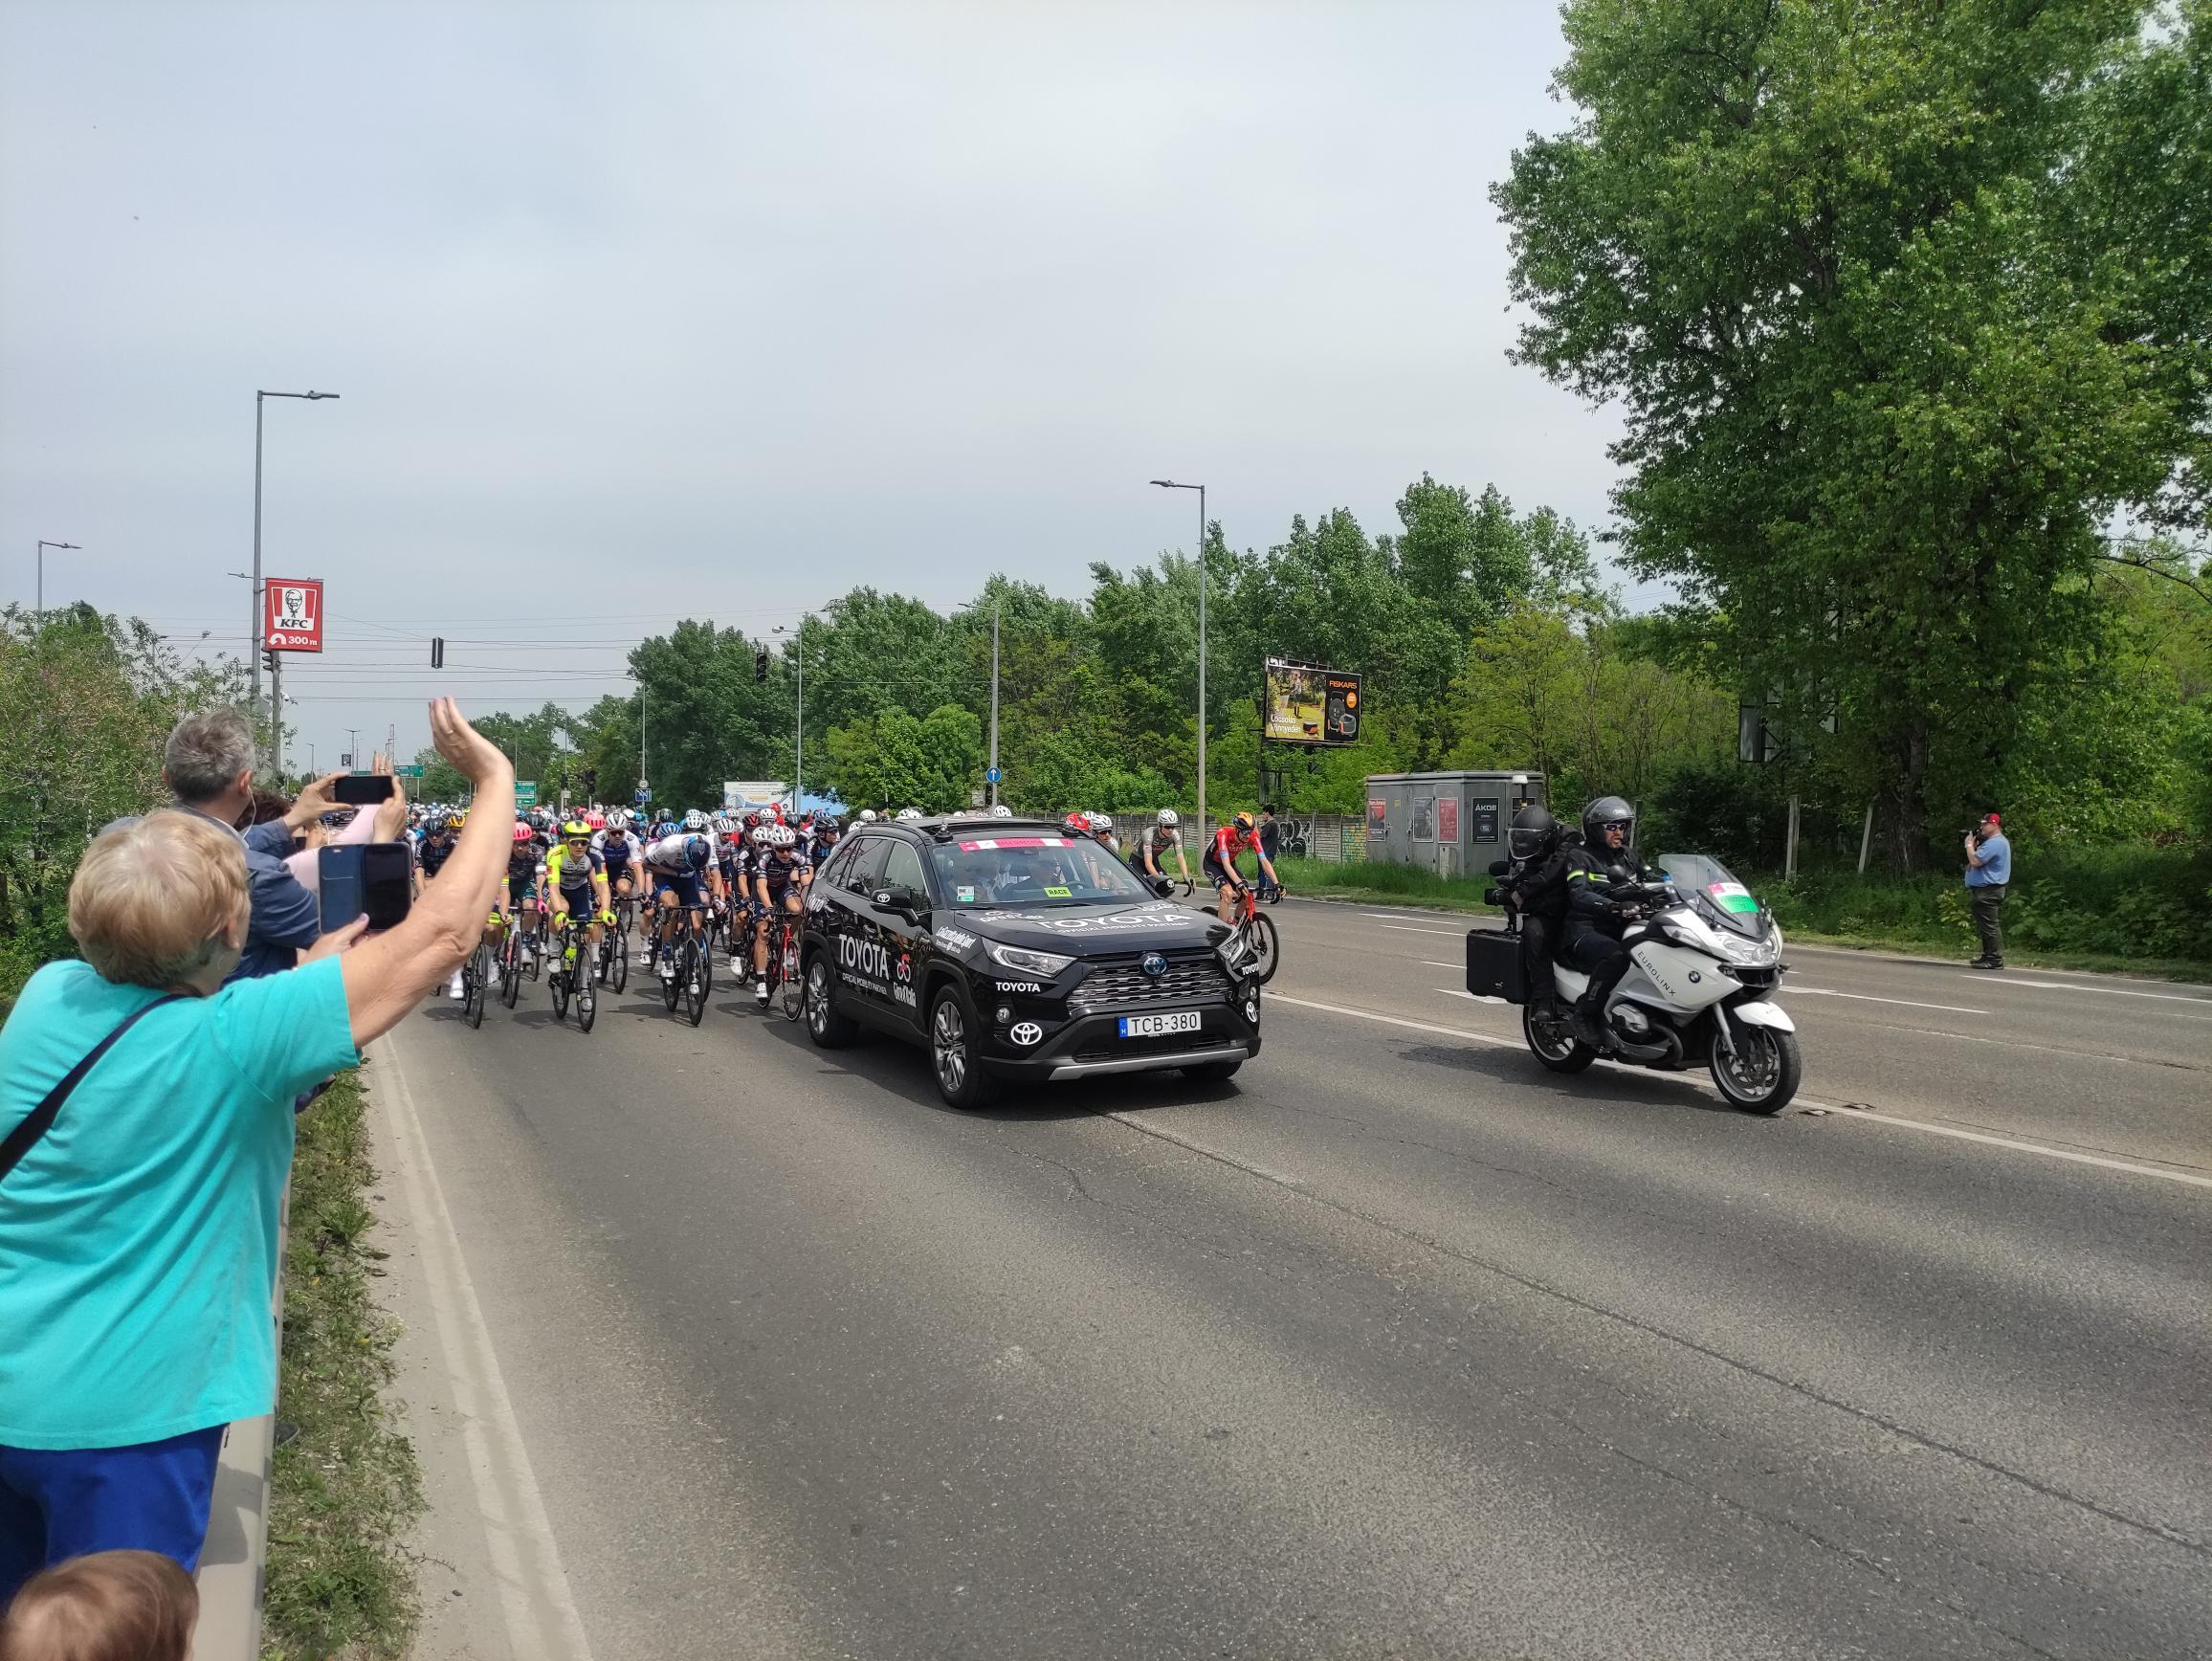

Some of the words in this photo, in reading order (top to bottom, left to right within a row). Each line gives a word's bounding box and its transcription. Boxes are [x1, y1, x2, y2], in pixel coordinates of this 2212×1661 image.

[279, 618, 308, 629] KFC
[288, 635, 309, 645] 300
[1329, 680, 1358, 690] FISKARS
[1474, 802, 1497, 812] ÁKOS
[1029, 914, 1194, 929] TOYOTA
[838, 934, 890, 981] TOYOTA
[1637, 950, 1676, 996] EUROLINX
[996, 982, 1041, 992] TOYOTA
[1131, 1013, 1198, 1034] TCB-380
